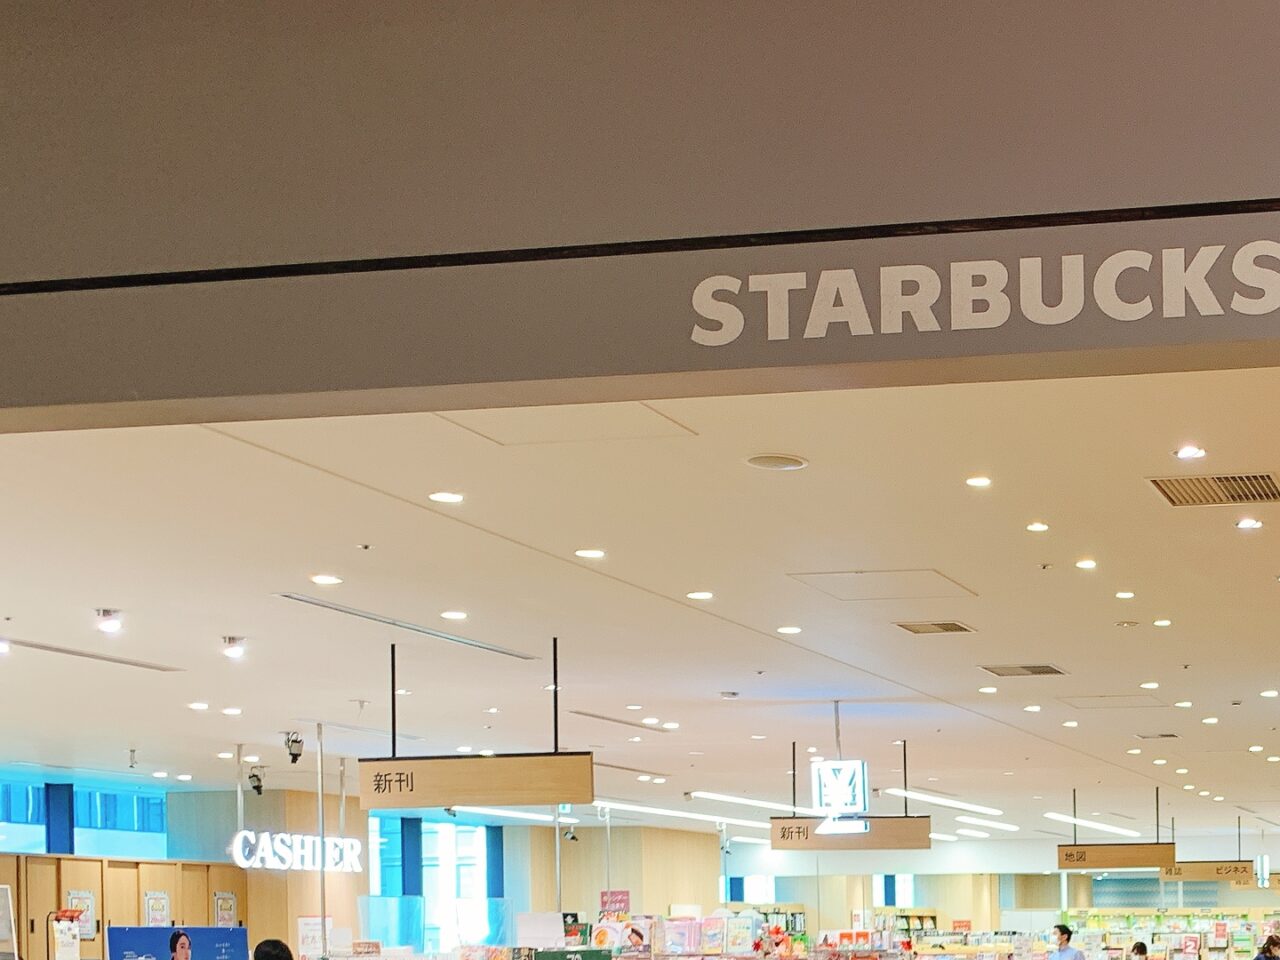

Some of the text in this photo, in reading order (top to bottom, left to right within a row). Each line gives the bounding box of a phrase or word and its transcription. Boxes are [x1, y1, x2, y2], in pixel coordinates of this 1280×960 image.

[373, 771, 414, 793] 新刊
[780, 826, 809, 840] 新刊
[233, 830, 362, 872] CASHIER
[1064, 851, 1086, 863] 地図
[1216, 866, 1248, 875] ビジネス
[1186, 941, 1195, 953] 2
